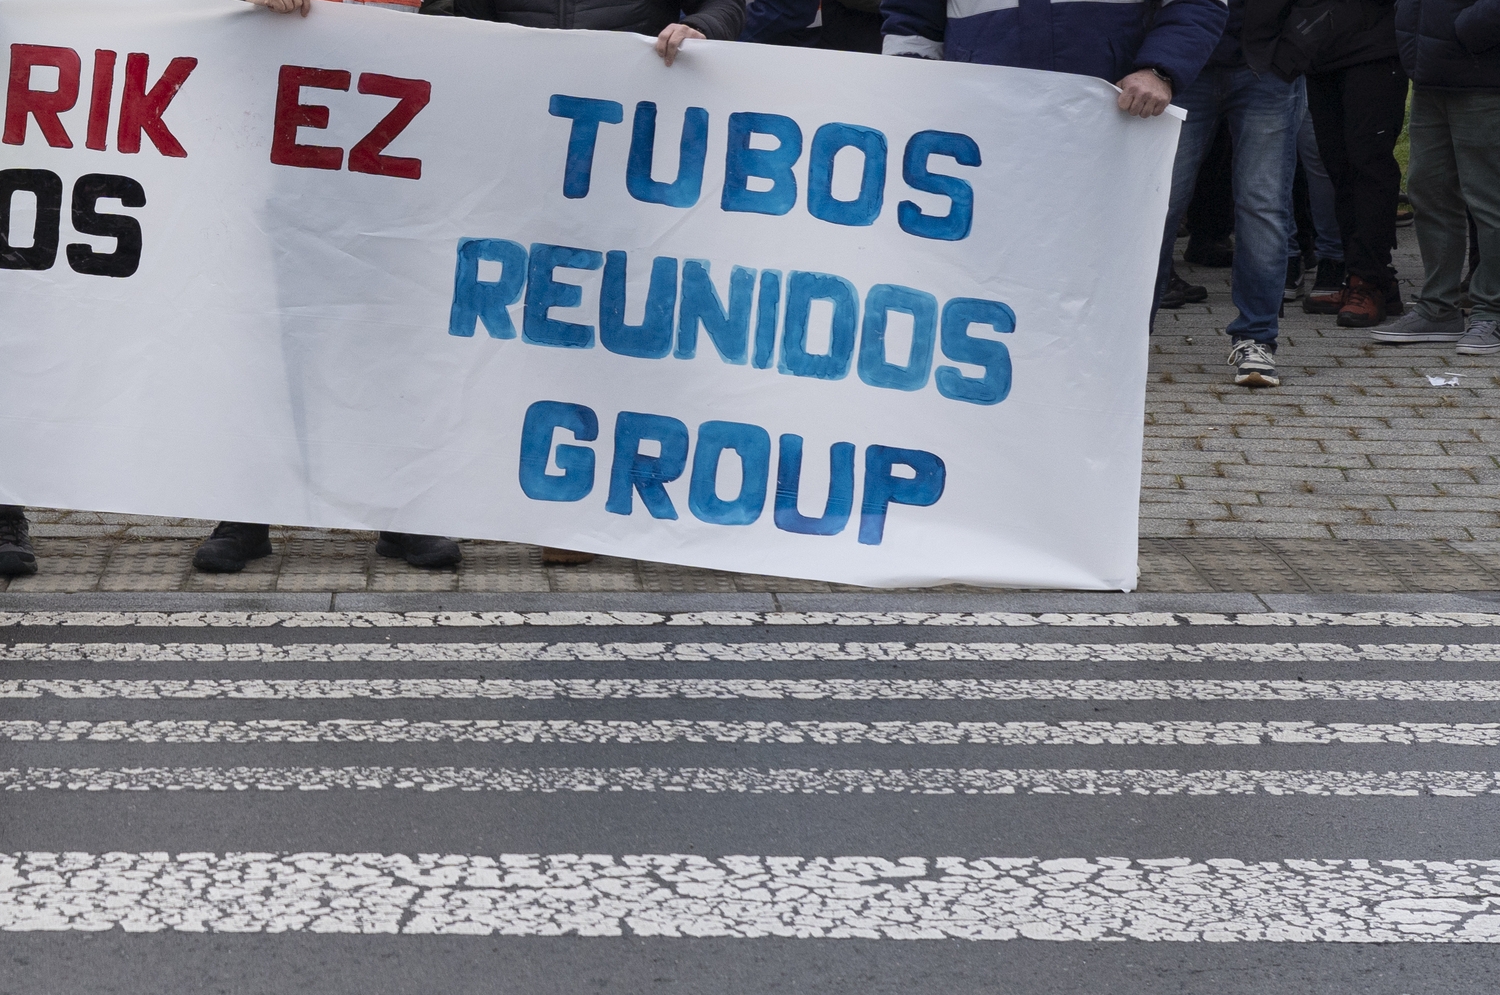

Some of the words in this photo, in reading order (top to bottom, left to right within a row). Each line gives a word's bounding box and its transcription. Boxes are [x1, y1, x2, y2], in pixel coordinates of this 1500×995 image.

[271, 65, 431, 179] EZ
[548, 93, 983, 242] TUBOS
[448, 237, 1018, 406] REUNIDOS
[518, 400, 947, 546] GROUP
